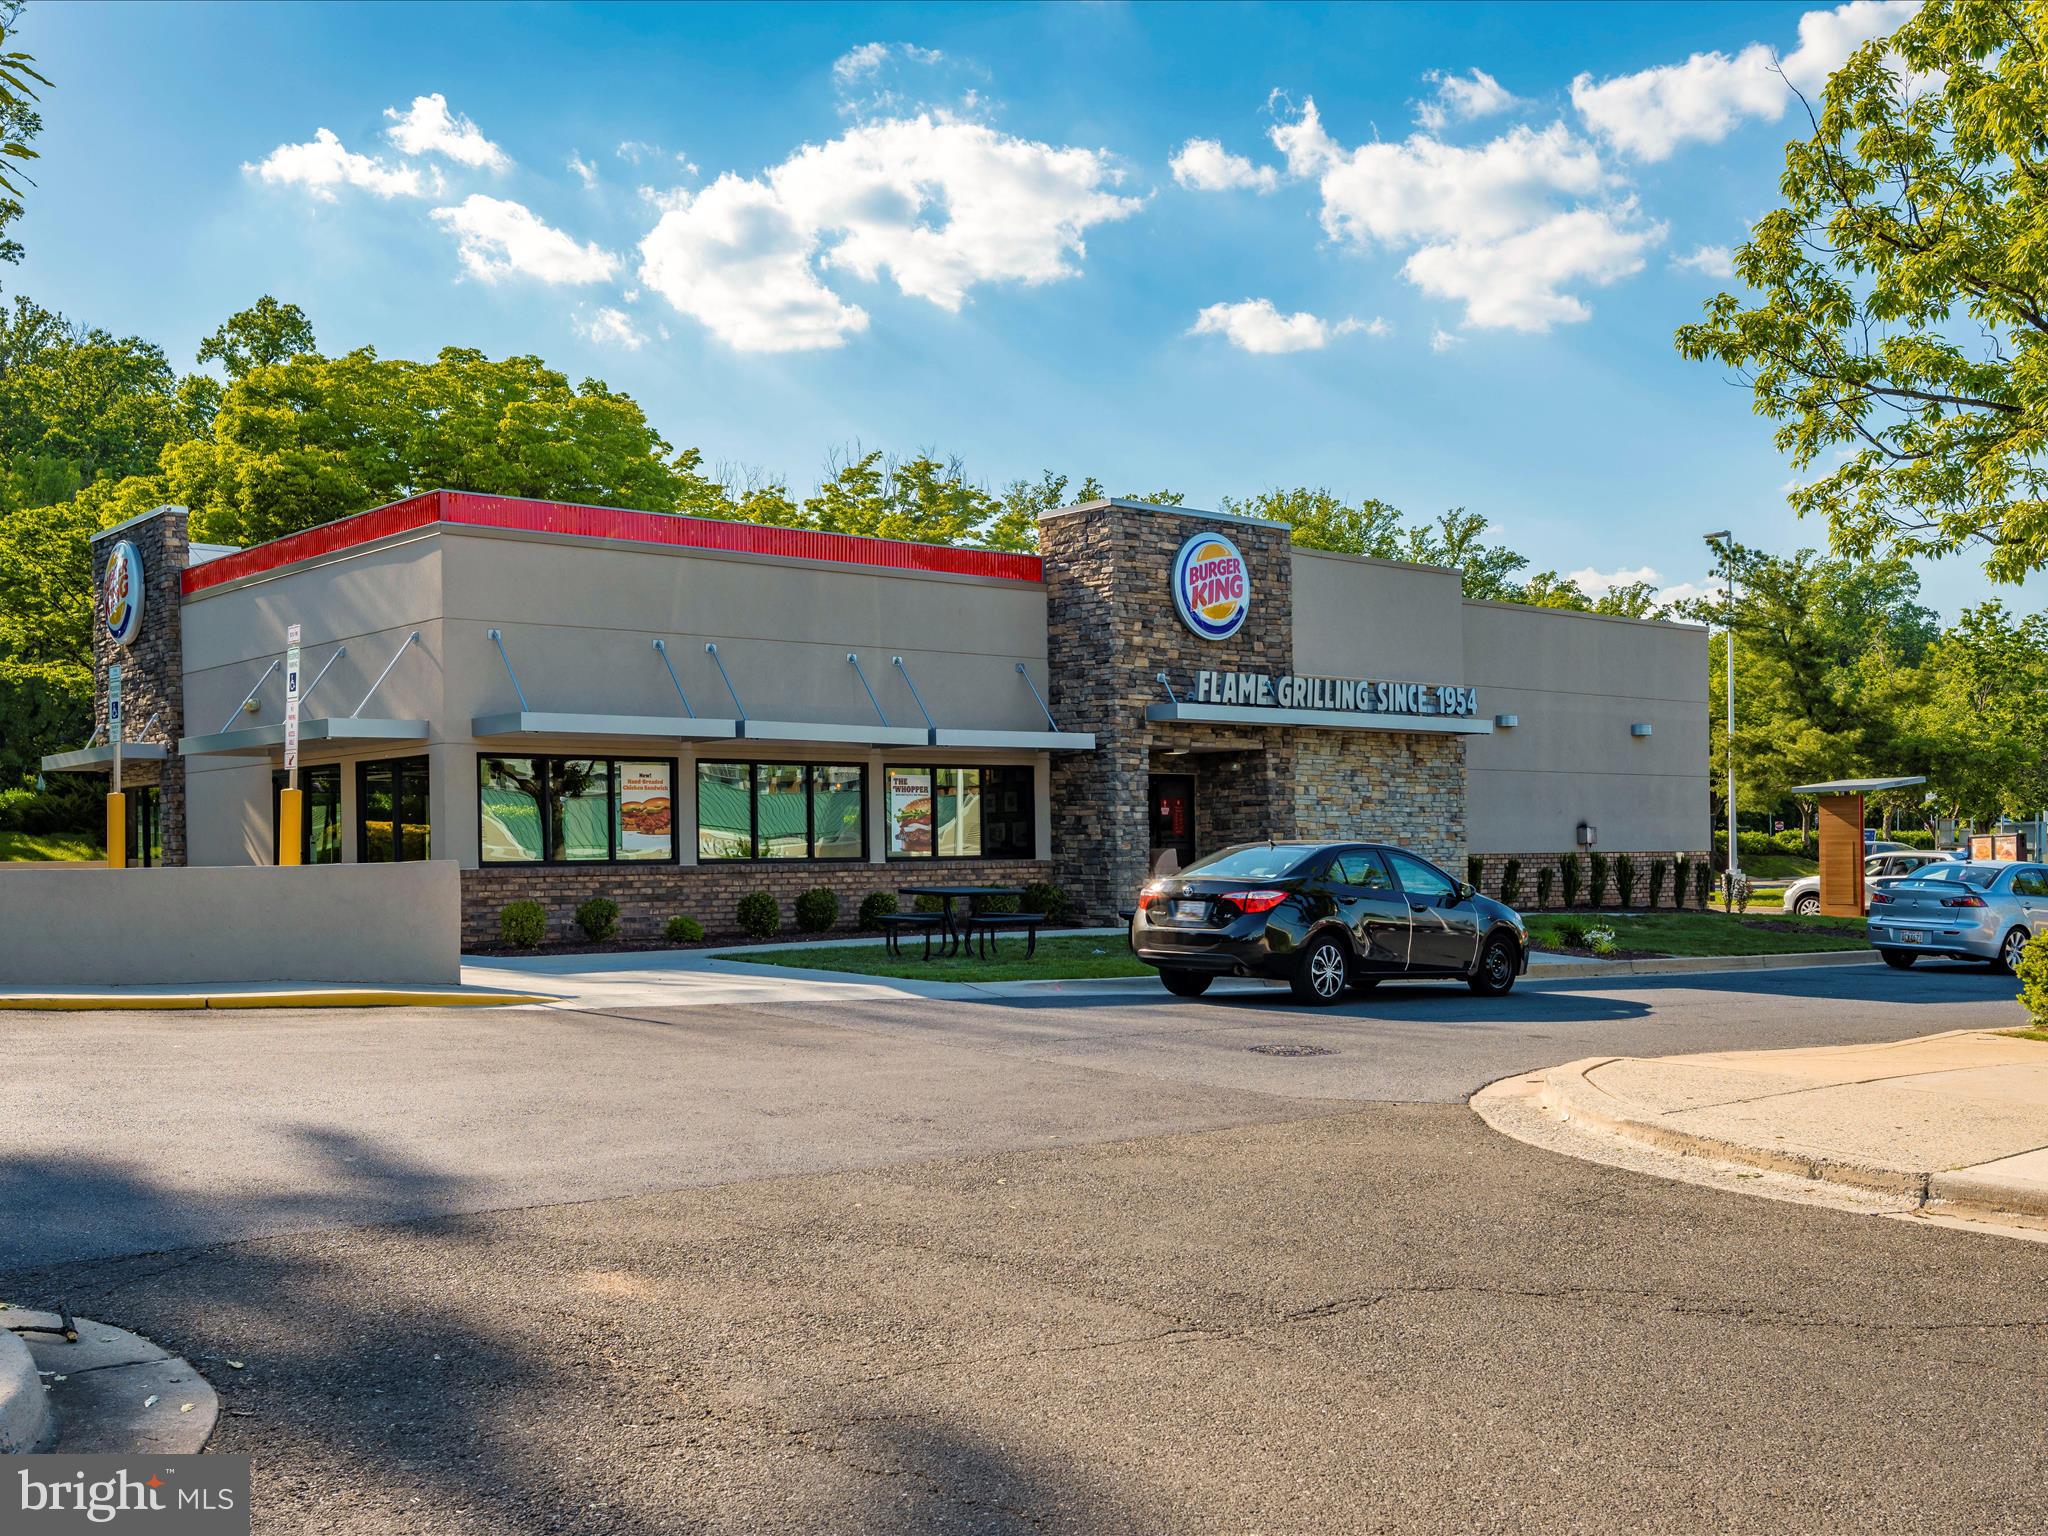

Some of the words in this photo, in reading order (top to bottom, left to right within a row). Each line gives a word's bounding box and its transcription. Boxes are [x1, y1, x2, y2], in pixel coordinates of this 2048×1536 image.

[1189, 558, 1241, 586] BURGER
[1191, 575, 1243, 609] KING
[1197, 670, 1269, 705] FLAME
[1278, 676, 1368, 711] GRILLING
[1377, 682, 1429, 713] SINCE
[1436, 686, 1478, 716] 1954
